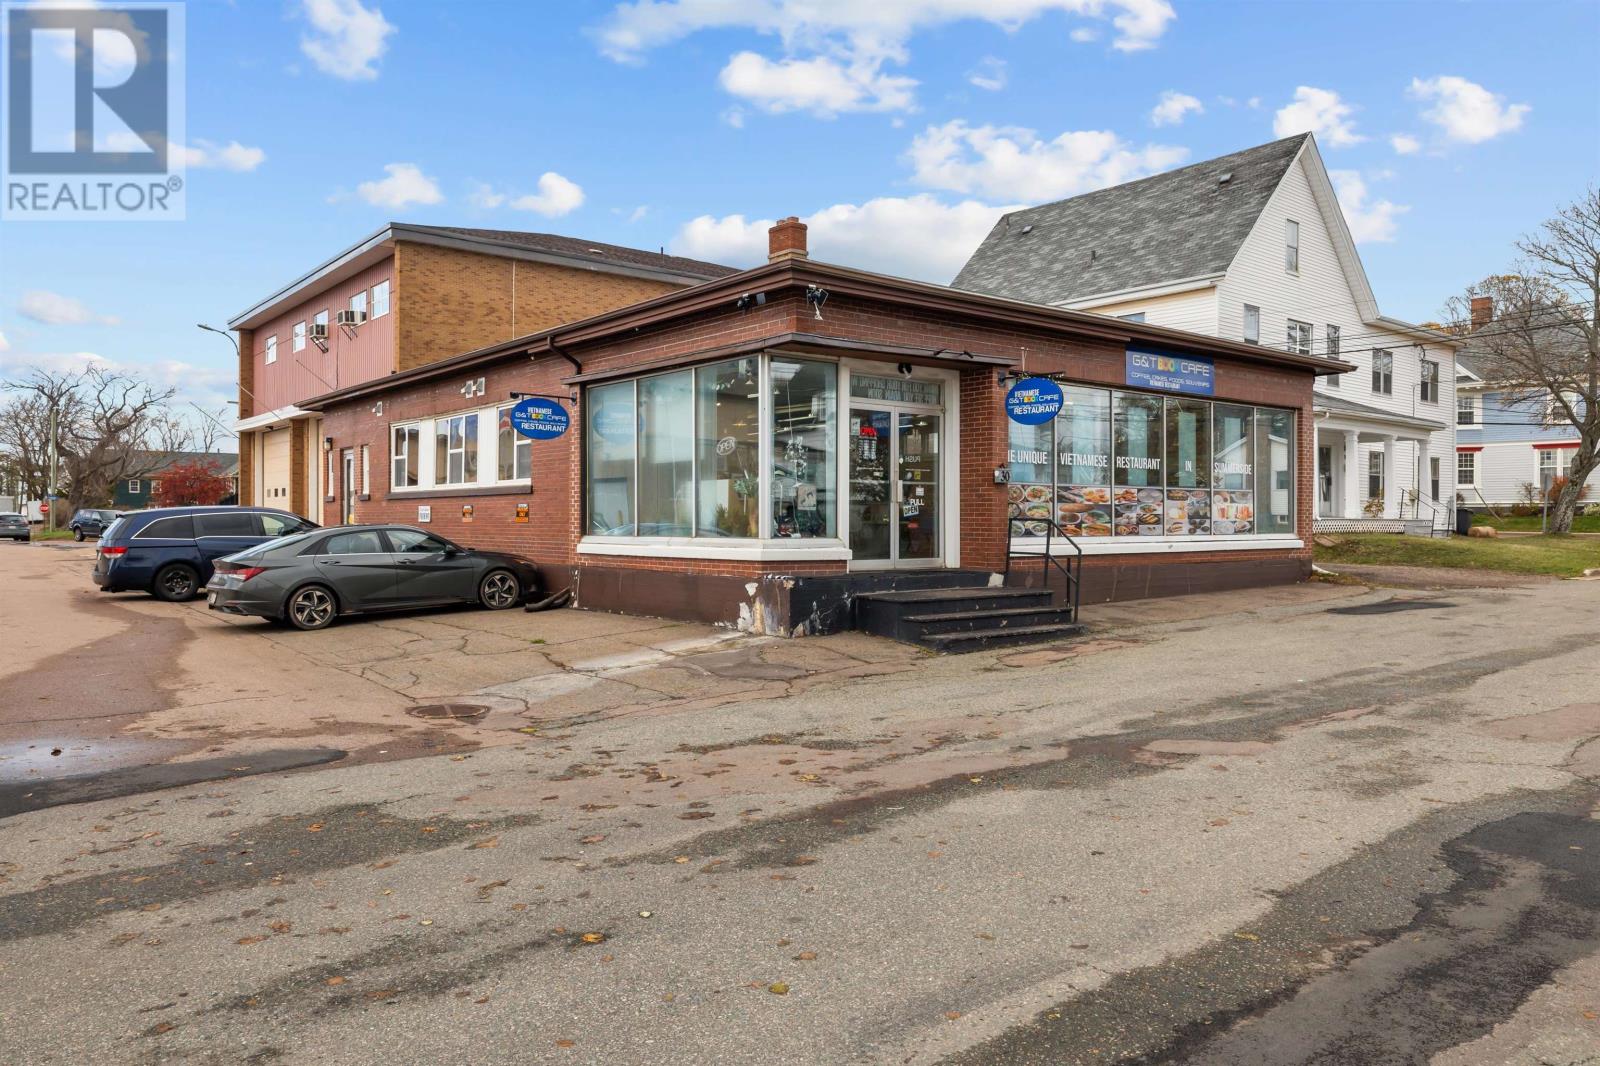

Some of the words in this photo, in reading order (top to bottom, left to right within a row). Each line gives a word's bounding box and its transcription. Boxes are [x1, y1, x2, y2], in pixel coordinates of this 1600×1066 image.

[1132, 355, 1156, 368] G&T
[1158, 356, 1178, 372] BOO
[1181, 362, 1210, 376] CAFE
[1014, 404, 1059, 414] RESTAURANT
[521, 423, 566, 432] RESTAURANT
[1017, 450, 1048, 465] UNIQUE
[1060, 452, 1108, 467] VIETNAMESE
[1116, 456, 1161, 470] RESTAURANT
[1184, 460, 1193, 472] IN
[1214, 462, 1252, 475] SUMMERSIDE
[910, 498, 924, 506] PULL
[903, 506, 918, 516] OPEN
